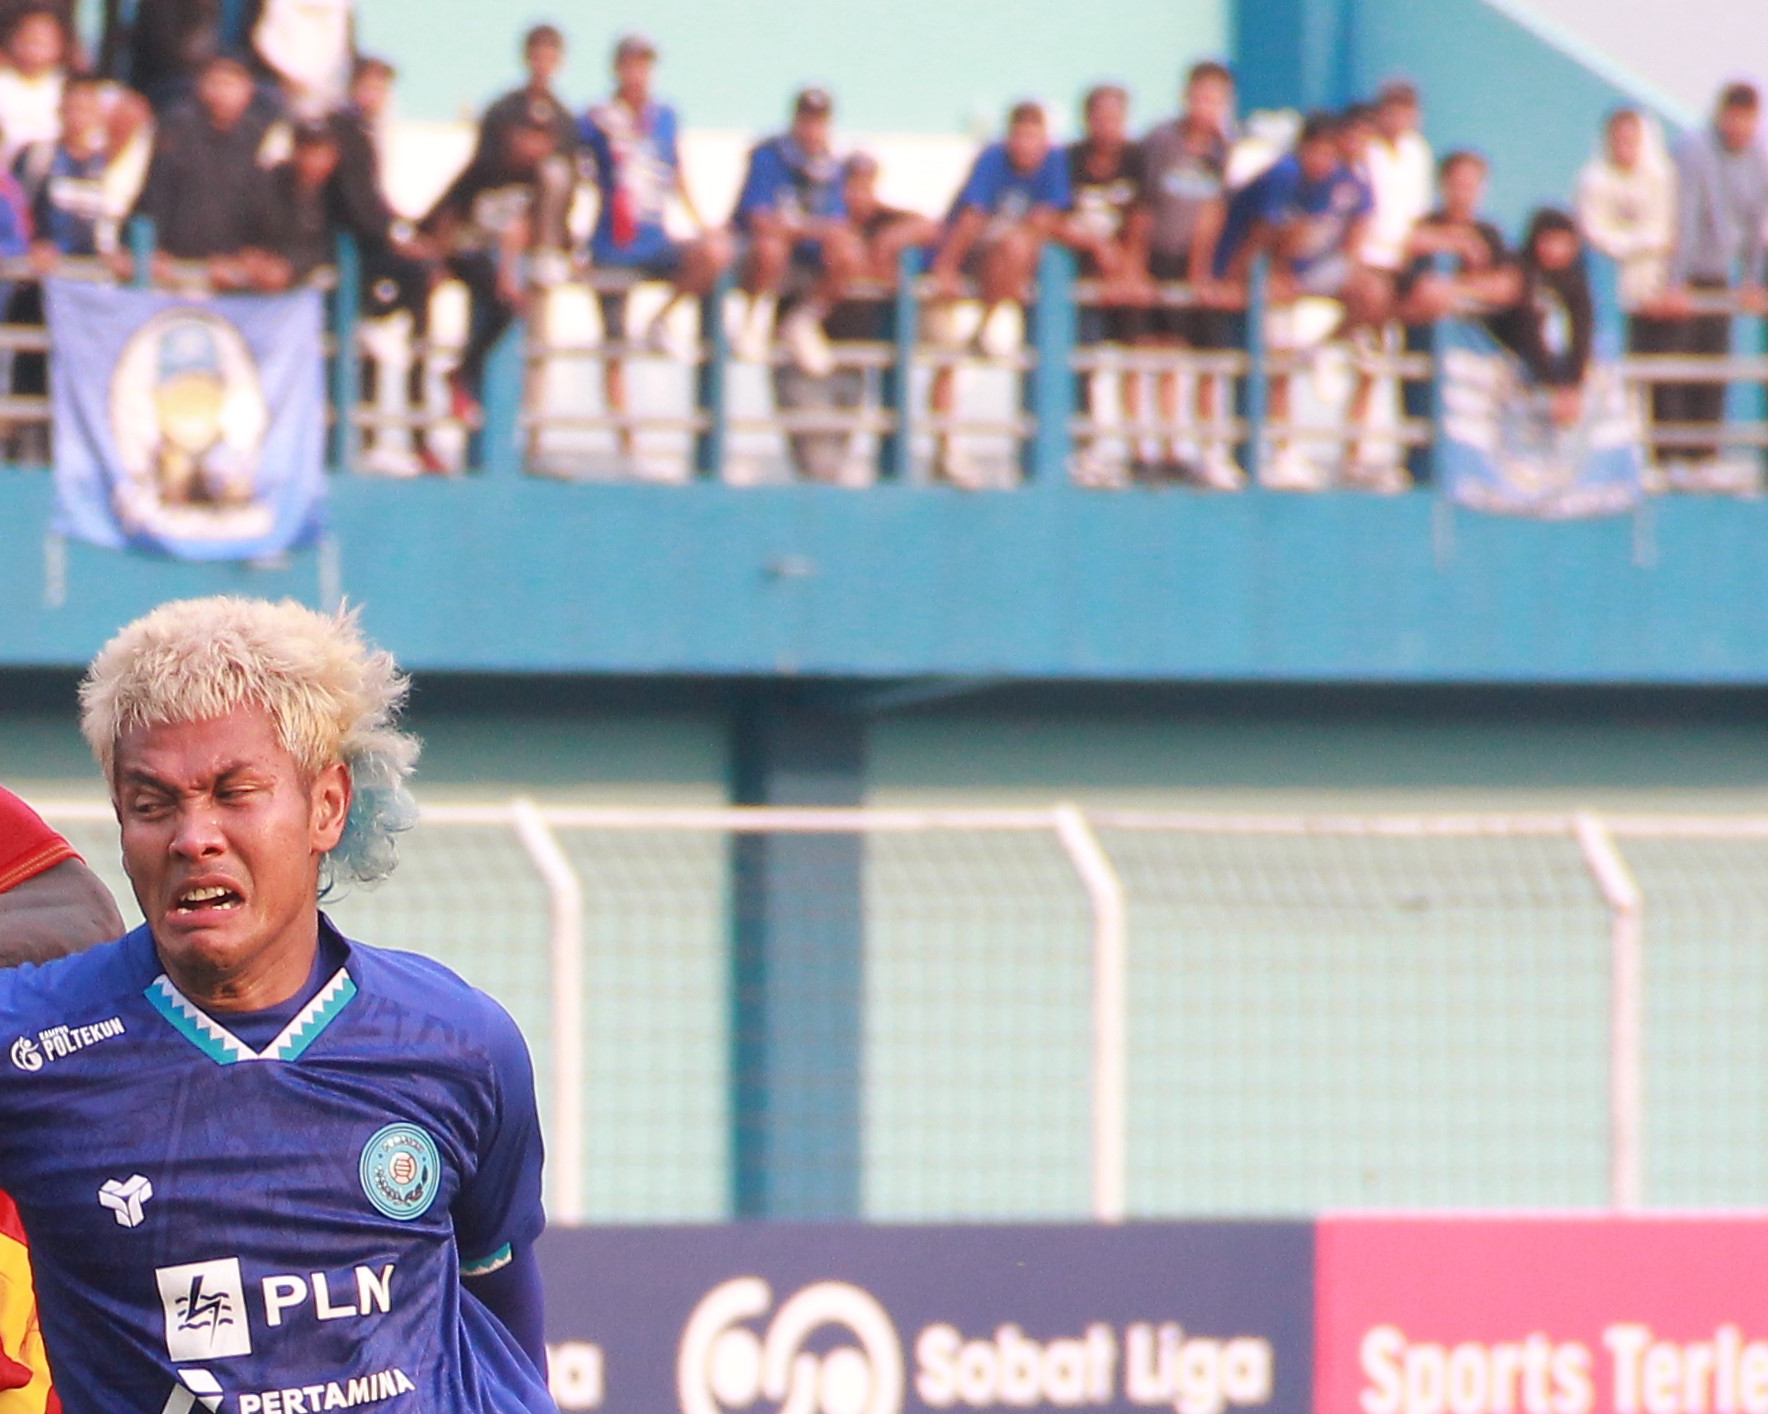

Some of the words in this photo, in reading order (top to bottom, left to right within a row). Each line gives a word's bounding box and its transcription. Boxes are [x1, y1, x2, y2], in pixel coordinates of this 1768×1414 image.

[42, 1016, 126, 1062] POLTEKUN
[261, 1264, 396, 1328] PLN
[912, 1322, 1118, 1408] Sobat
